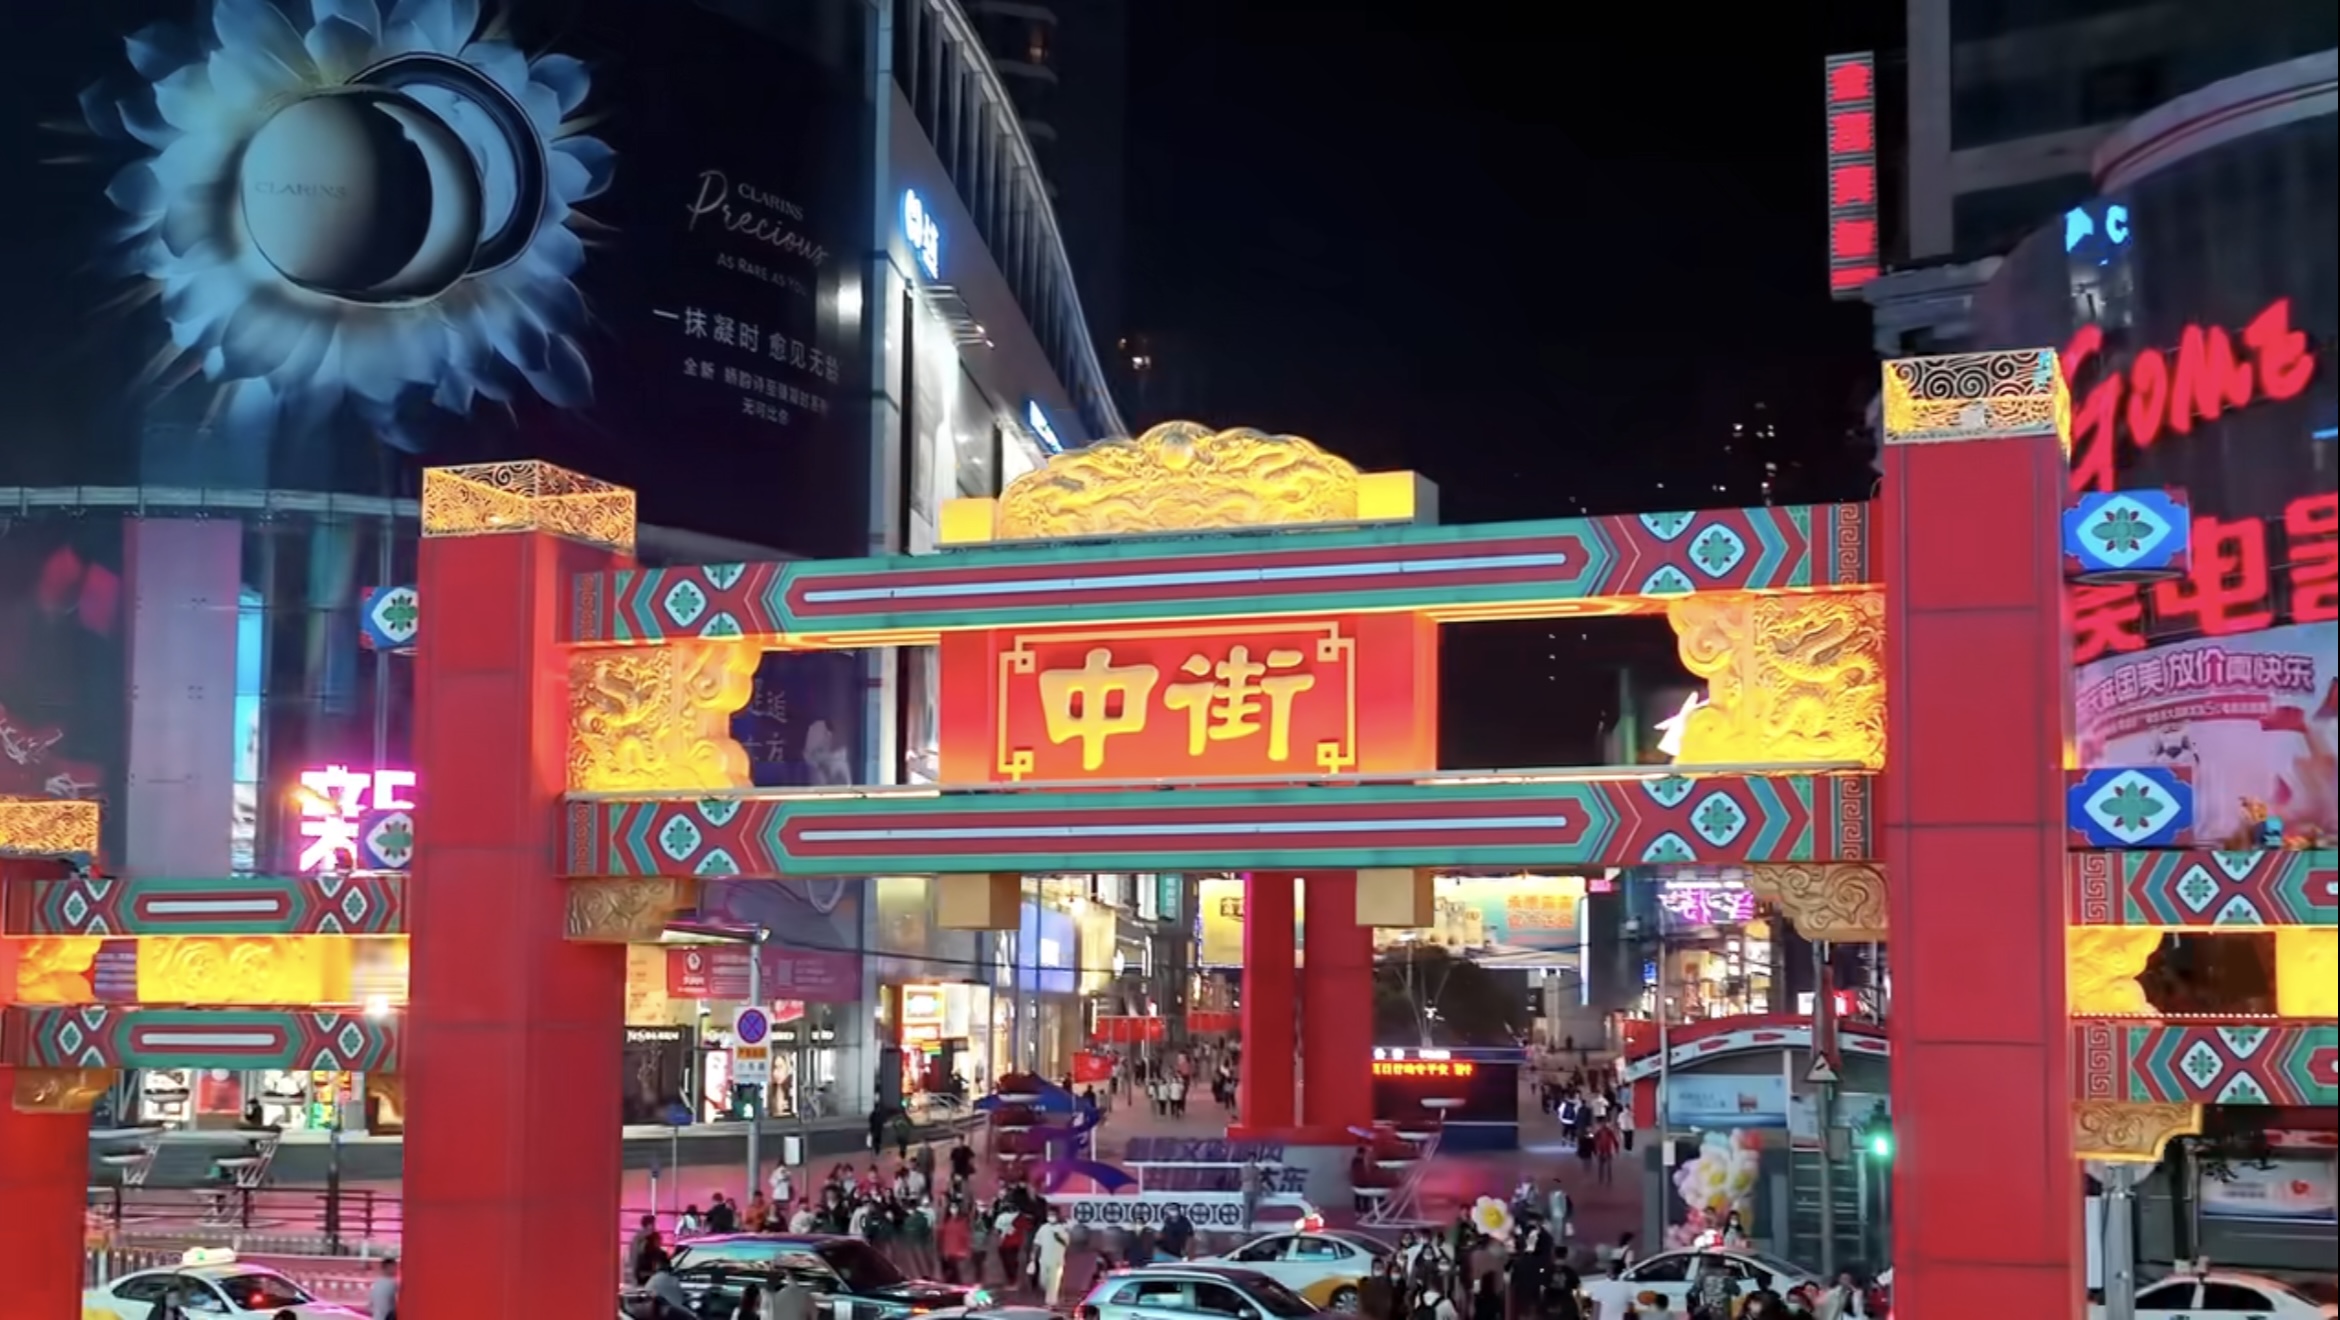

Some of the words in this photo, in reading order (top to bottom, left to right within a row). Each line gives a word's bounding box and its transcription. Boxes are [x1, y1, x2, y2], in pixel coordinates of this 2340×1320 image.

[685, 169, 829, 267] Precious
[737, 182, 804, 222] CLARINS
[716, 252, 735, 271] AS
[737, 257, 768, 282] RARE
[652, 305, 760, 353] 一抹凝时
[1039, 645, 1315, 771] 中街
